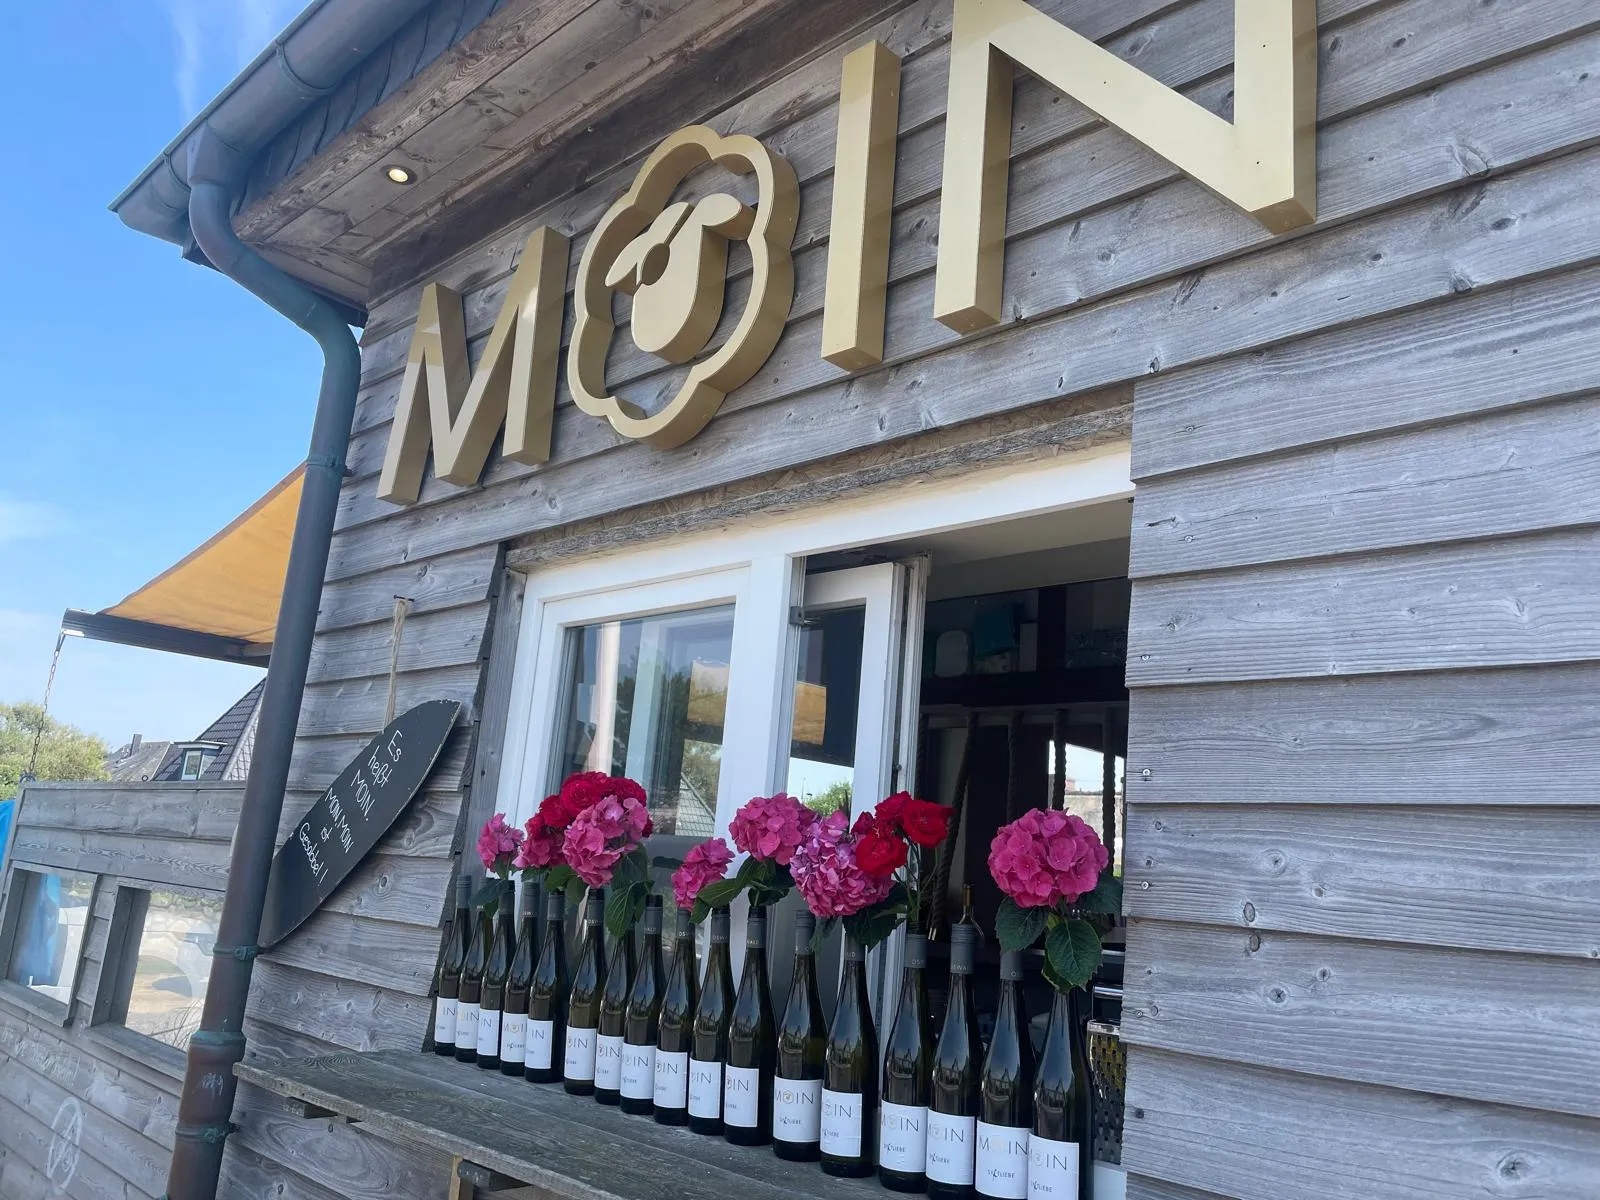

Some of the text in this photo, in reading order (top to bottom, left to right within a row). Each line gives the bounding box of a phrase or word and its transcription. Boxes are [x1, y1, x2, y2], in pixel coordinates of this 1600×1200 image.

[377, 0, 1317, 505] MOIN
[368, 745, 393, 788] heißt
[388, 730, 403, 762] Es
[351, 769, 376, 821] MOIN.
